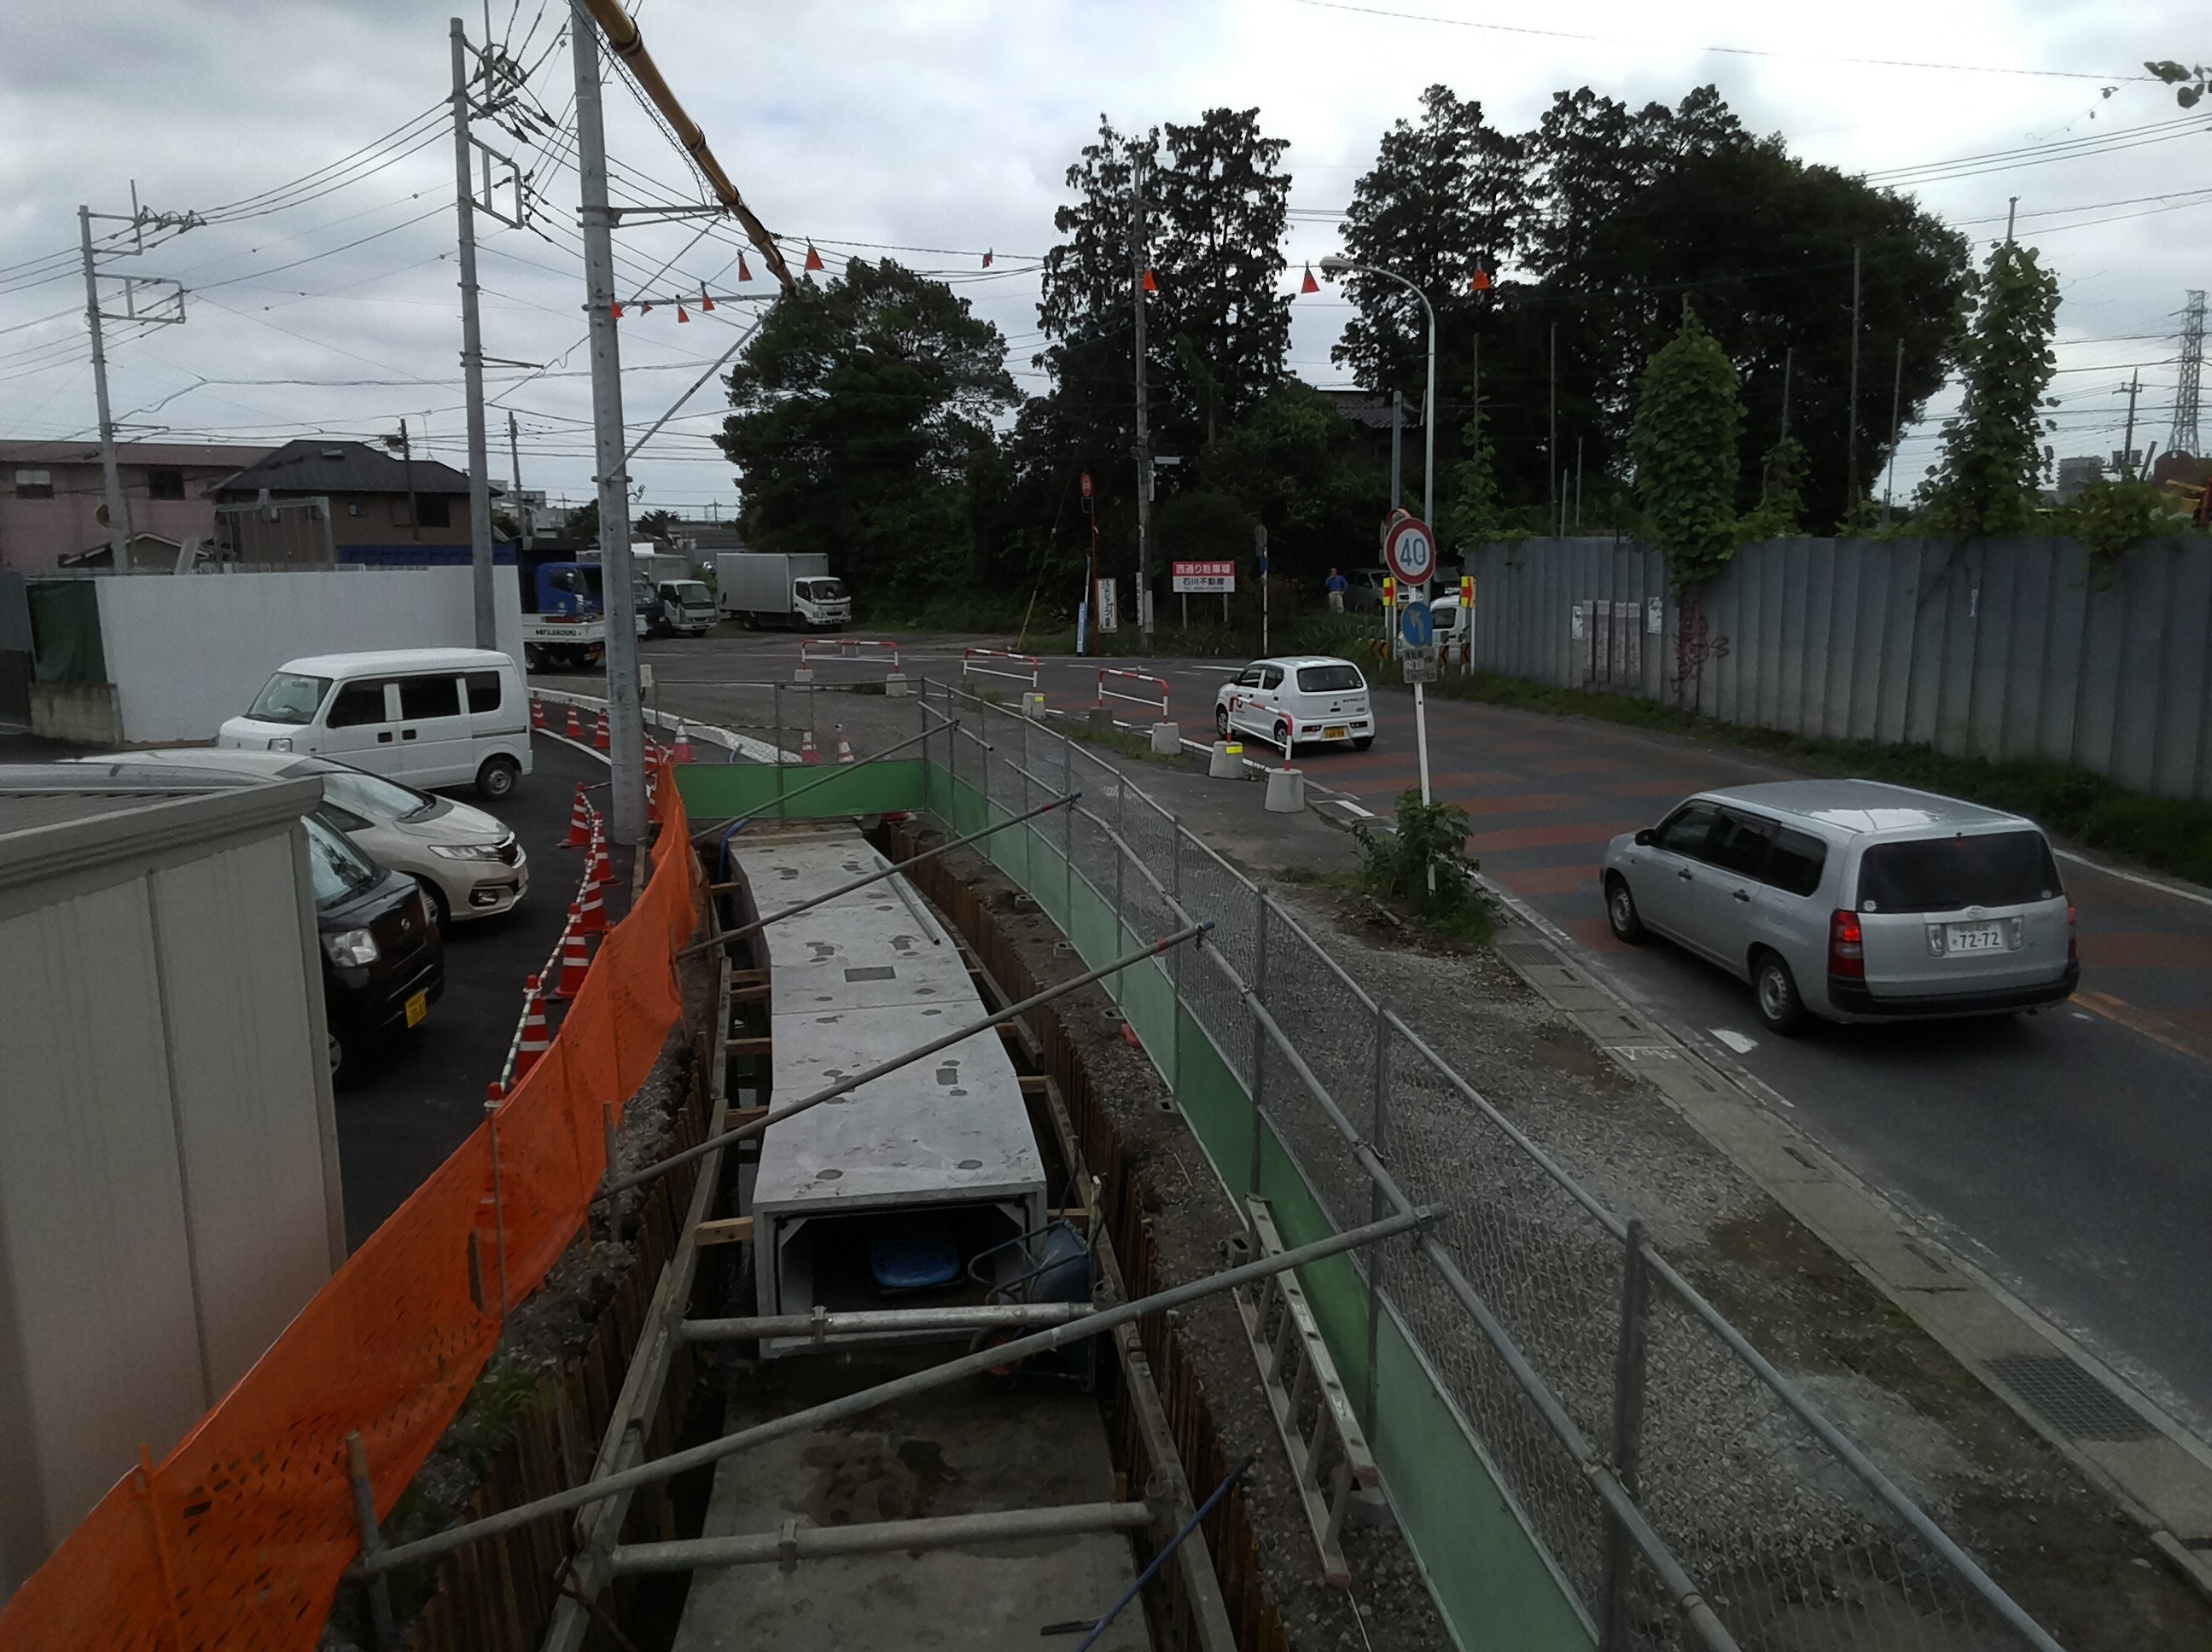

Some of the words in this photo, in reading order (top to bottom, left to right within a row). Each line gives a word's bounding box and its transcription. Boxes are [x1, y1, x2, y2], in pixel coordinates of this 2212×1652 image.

[1400, 538, 1426, 567] 40
[1182, 577, 1225, 585] 石川不動産
[1959, 932, 2000, 949] 72-72
